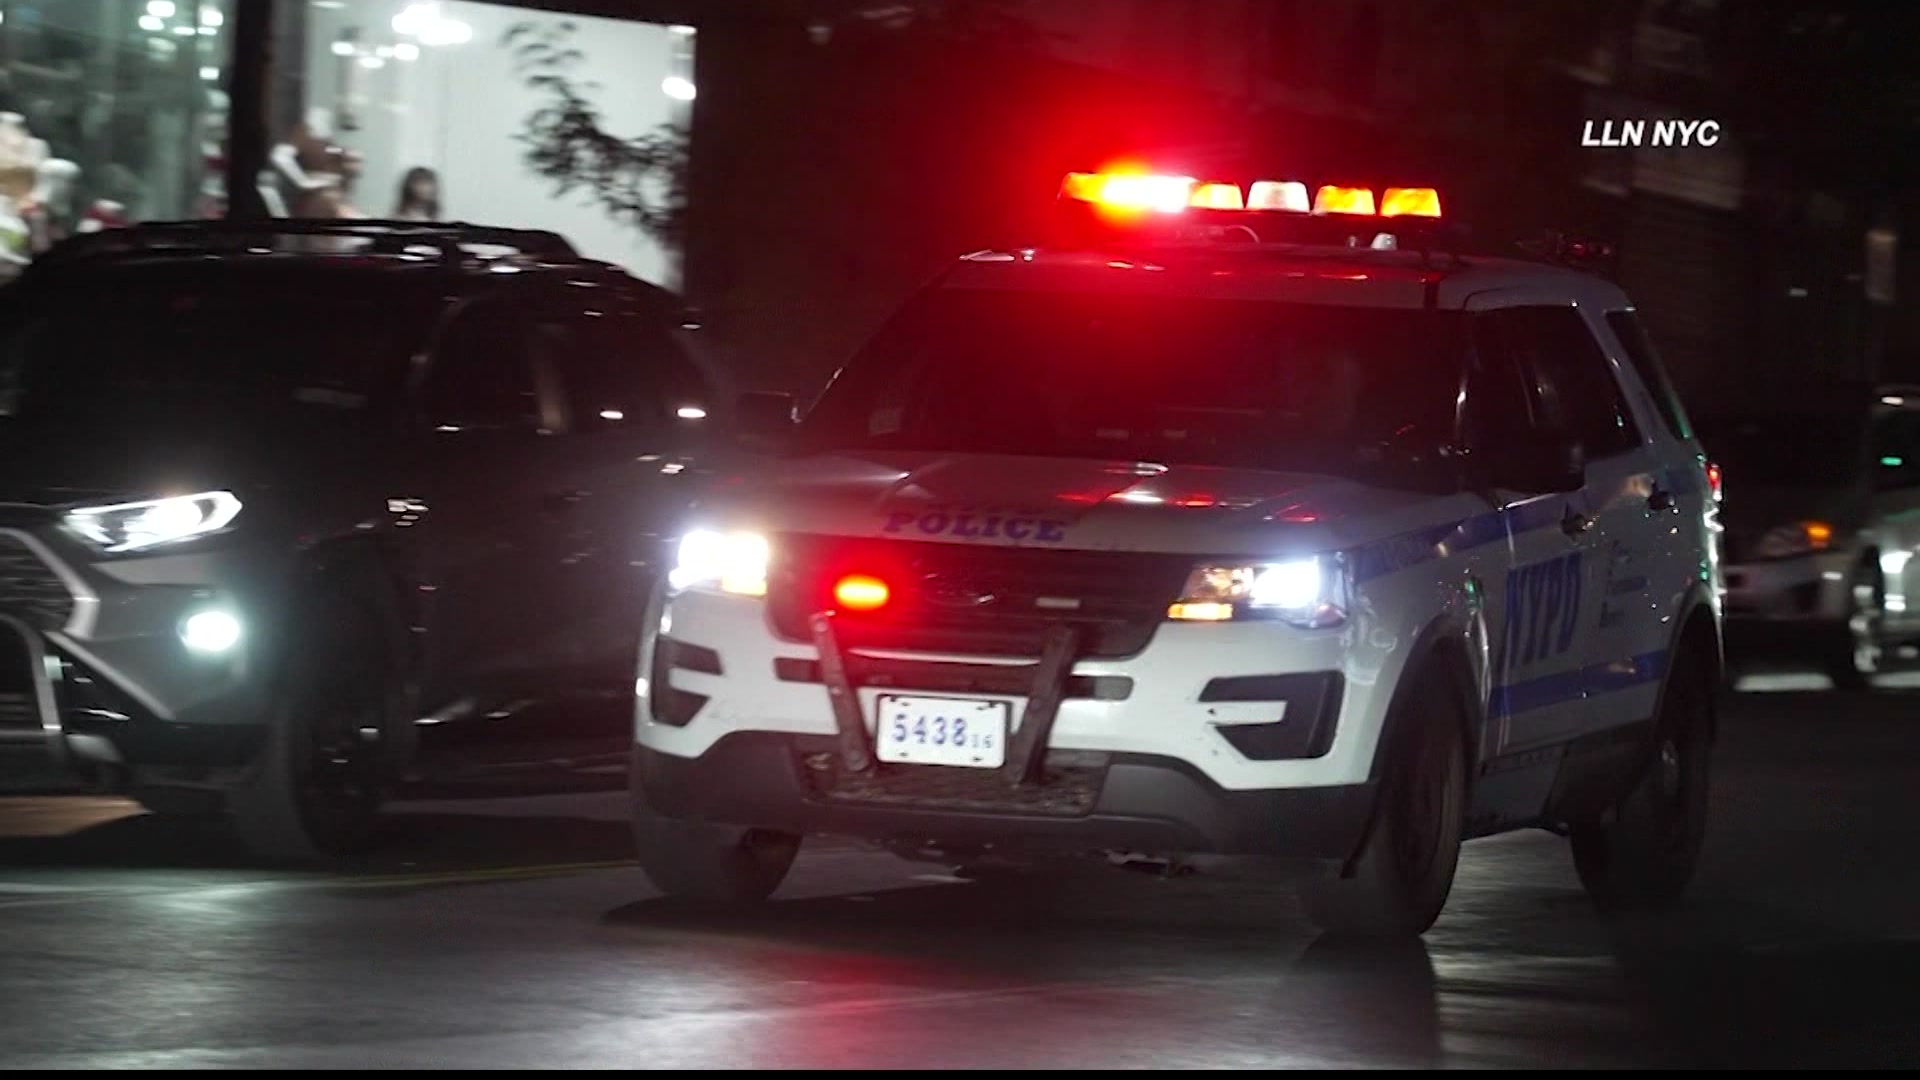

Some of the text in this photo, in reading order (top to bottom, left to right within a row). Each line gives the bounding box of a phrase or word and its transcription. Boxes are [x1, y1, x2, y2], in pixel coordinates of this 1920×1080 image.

[883, 511, 1068, 542] POLICE
[1496, 552, 1582, 671] NYPD
[892, 713, 968, 747] 5438
